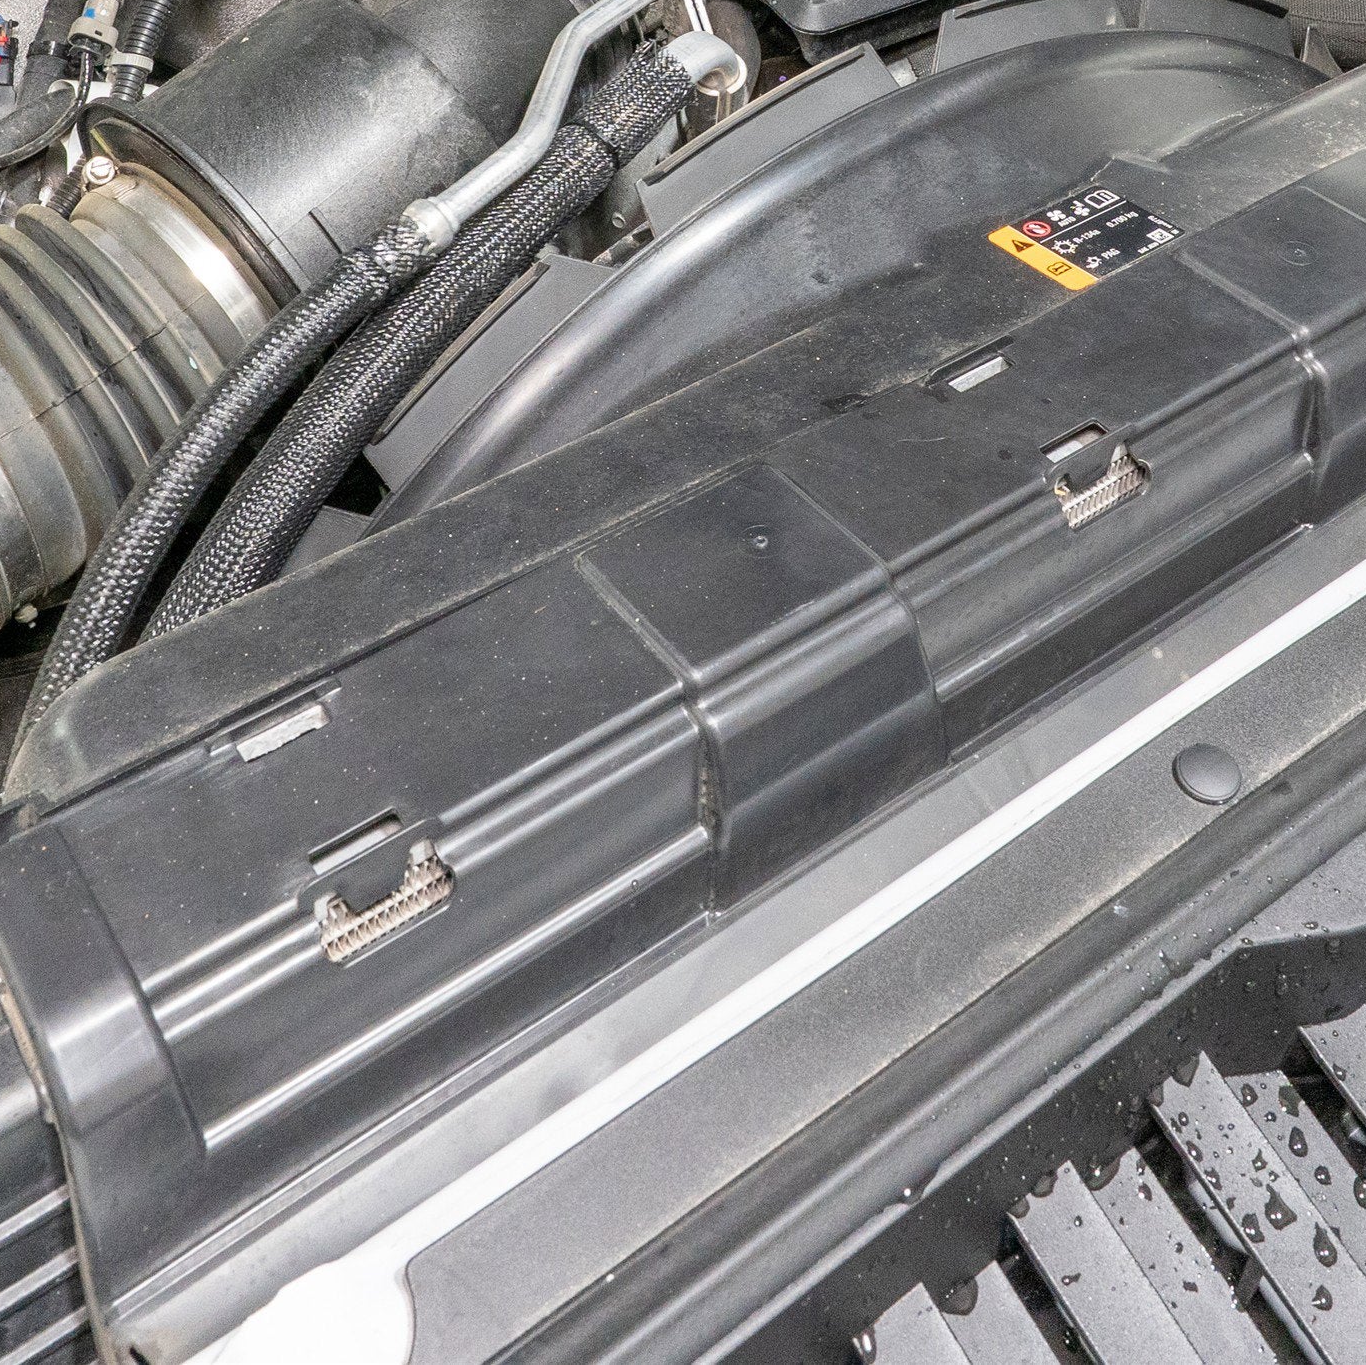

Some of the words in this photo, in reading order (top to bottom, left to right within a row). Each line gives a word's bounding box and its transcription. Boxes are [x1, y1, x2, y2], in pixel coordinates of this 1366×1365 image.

[1058, 216, 1076, 227] AUTO
[1073, 229, 1101, 244] R-134a
[1101, 248, 1121, 260] PAG
